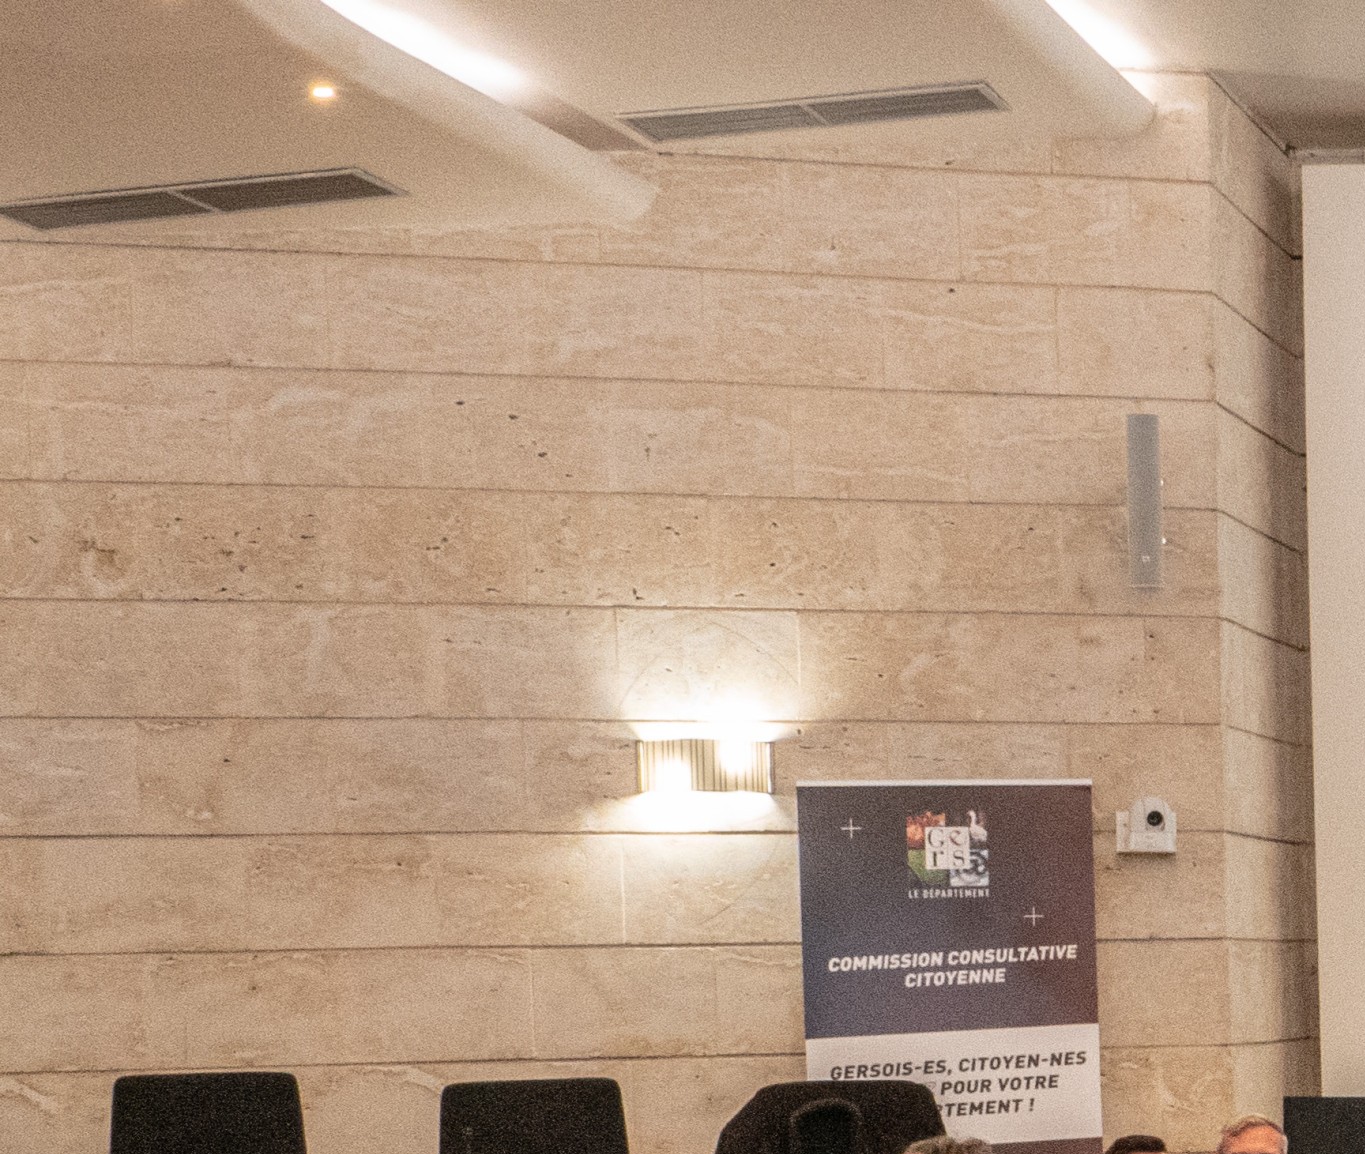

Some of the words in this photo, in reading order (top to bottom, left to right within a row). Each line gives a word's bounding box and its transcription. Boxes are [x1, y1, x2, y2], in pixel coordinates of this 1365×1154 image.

[922, 888, 989, 898] DÉPARTEMENT
[828, 951, 943, 973] COMMISSION
[947, 944, 1078, 967] CONSULTATIVE
[905, 968, 1006, 988] CITOYENNE
[830, 1060, 952, 1081] GERSOIS-ES,
[958, 1051, 1087, 1073] CITOYEN-NES
[940, 1080, 992, 1095] POUR
[998, 1074, 1060, 1091] VOTRE
